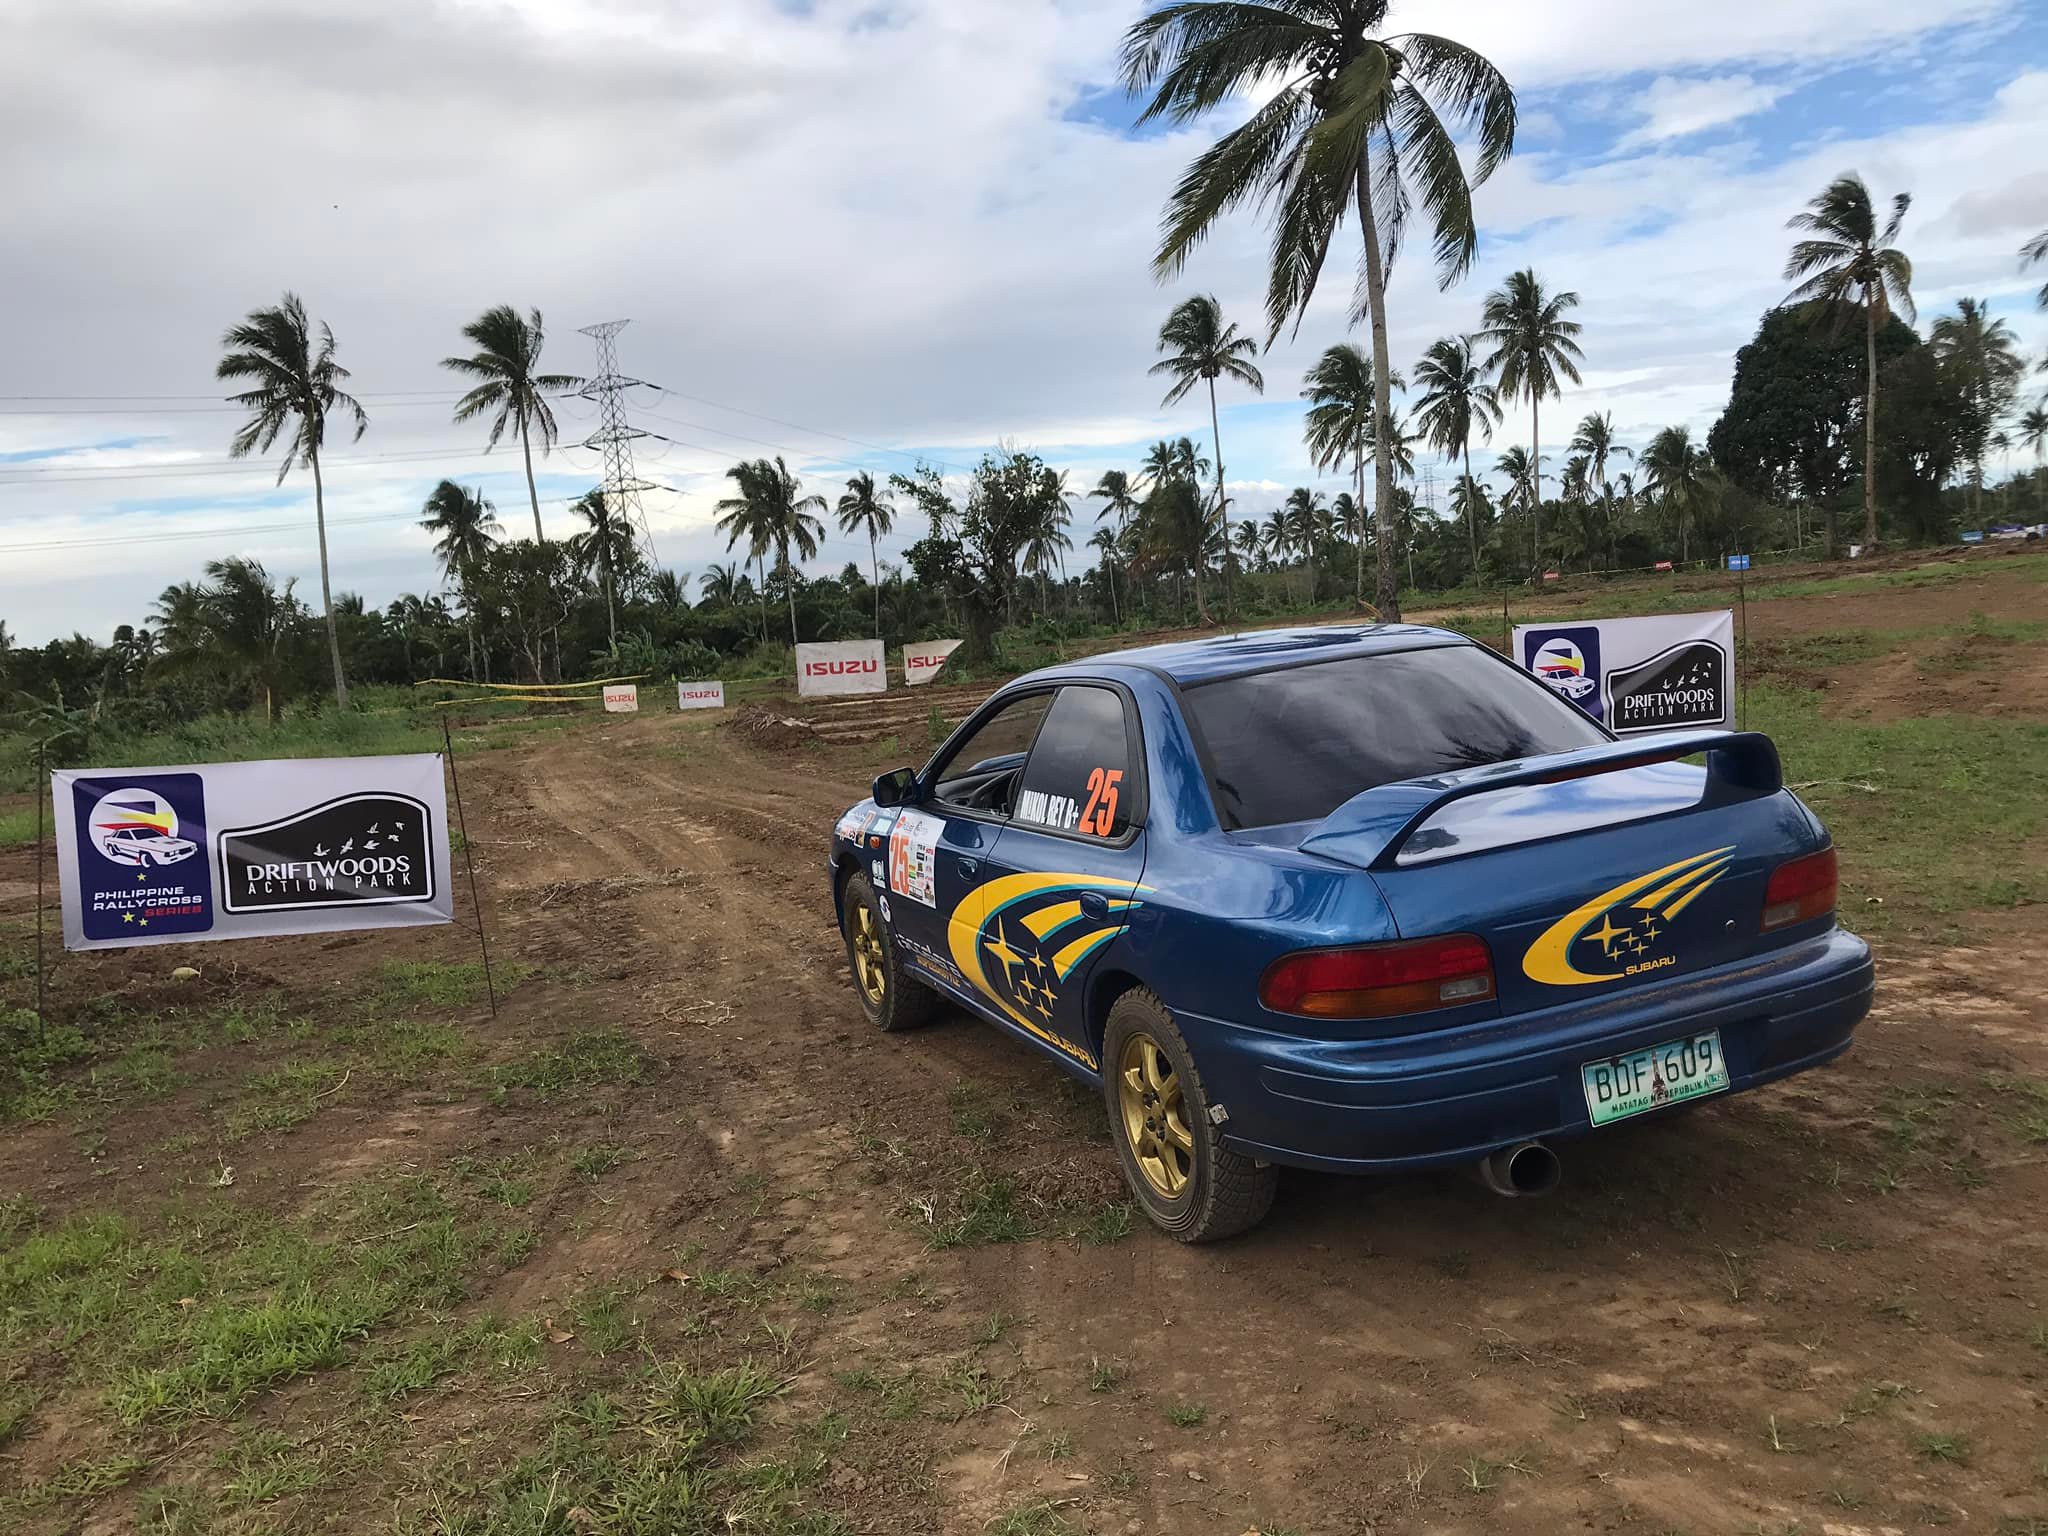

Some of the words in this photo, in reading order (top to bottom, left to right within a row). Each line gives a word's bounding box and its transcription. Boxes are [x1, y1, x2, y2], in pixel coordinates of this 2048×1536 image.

[806, 660, 878, 676] ISUZU
[605, 694, 635, 703] ISUZU
[682, 690, 720, 700] ISUZU
[1624, 688, 1714, 710] DRIFTWOODS
[1624, 706, 1674, 720] ACTION
[1683, 701, 1715, 714] PARK
[1020, 790, 1049, 824] MIKOL
[1046, 794, 1068, 828] REY
[1078, 767, 1124, 837] 25
[247, 856, 411, 881] DRIFTWOODS
[889, 833, 910, 896] 25
[94, 886, 185, 901] PHILIPPINE
[247, 876, 336, 896] ACTION
[354, 872, 412, 889] PARK
[93, 895, 203, 911] RALLYCROSS
[144, 905, 203, 917] SERIES
[1625, 955, 1676, 975] SUBARU
[1048, 1030, 1098, 1071] SUBARU
[1595, 1057, 1647, 1103] BDF
[1664, 1039, 1713, 1083] 609
[1611, 1096, 1649, 1113] MATATAG
